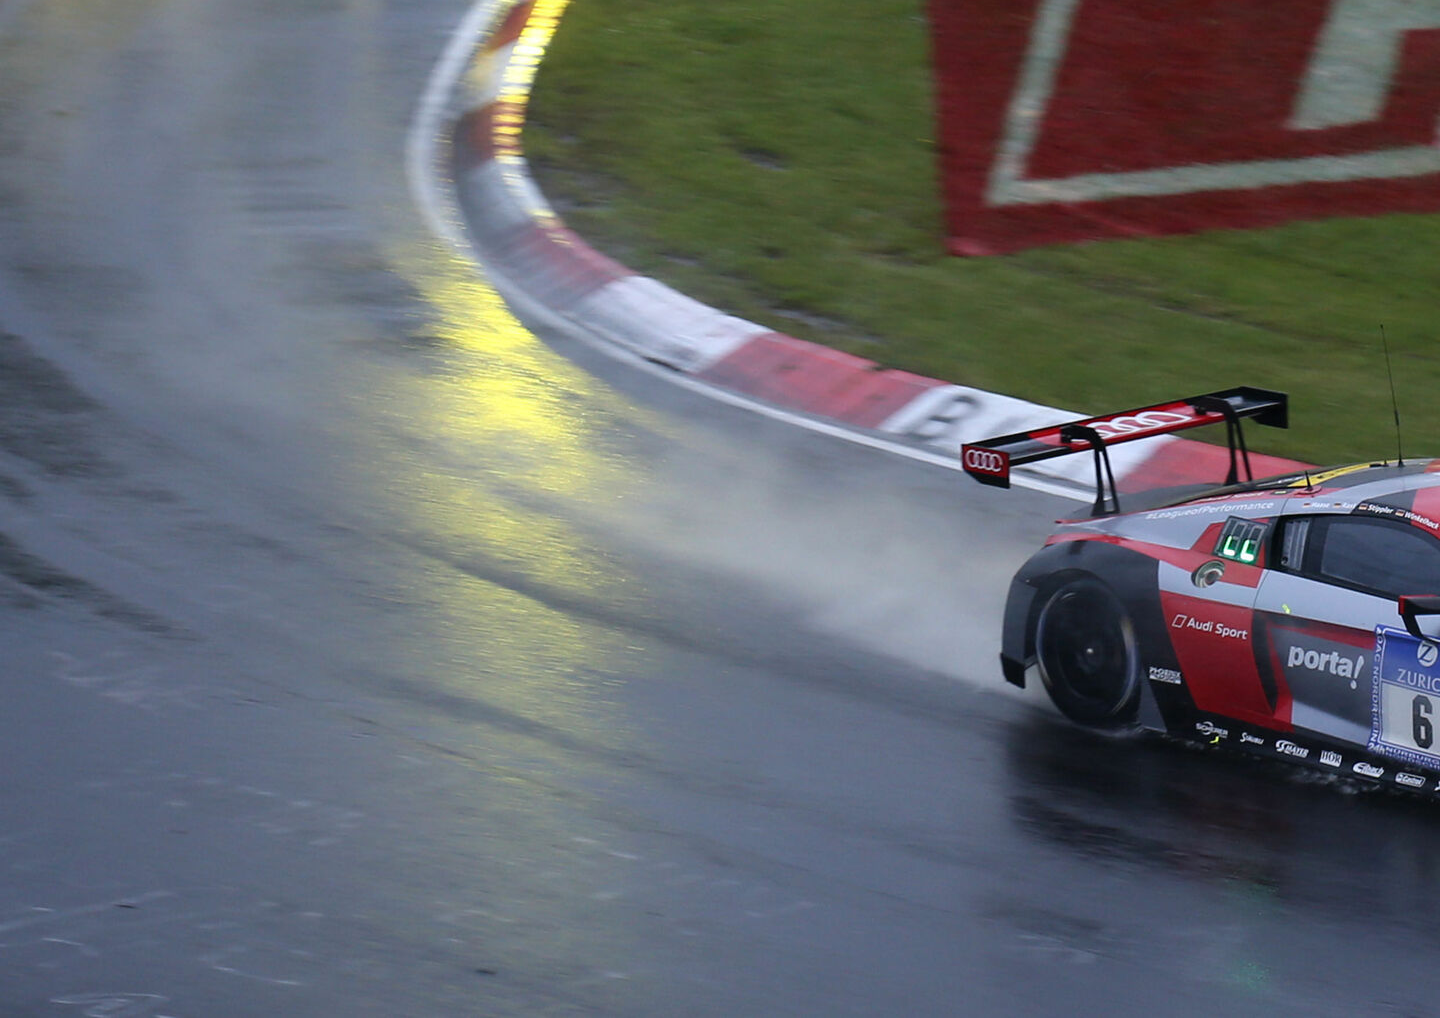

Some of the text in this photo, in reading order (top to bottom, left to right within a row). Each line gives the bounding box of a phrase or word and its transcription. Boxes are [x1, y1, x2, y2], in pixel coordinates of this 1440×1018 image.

[1145, 501, 1274, 520] #LeagueofPerformance
[1187, 617, 1248, 640] Audi Sport
[1287, 645, 1365, 689] porta!
[1412, 694, 1433, 750] 6
